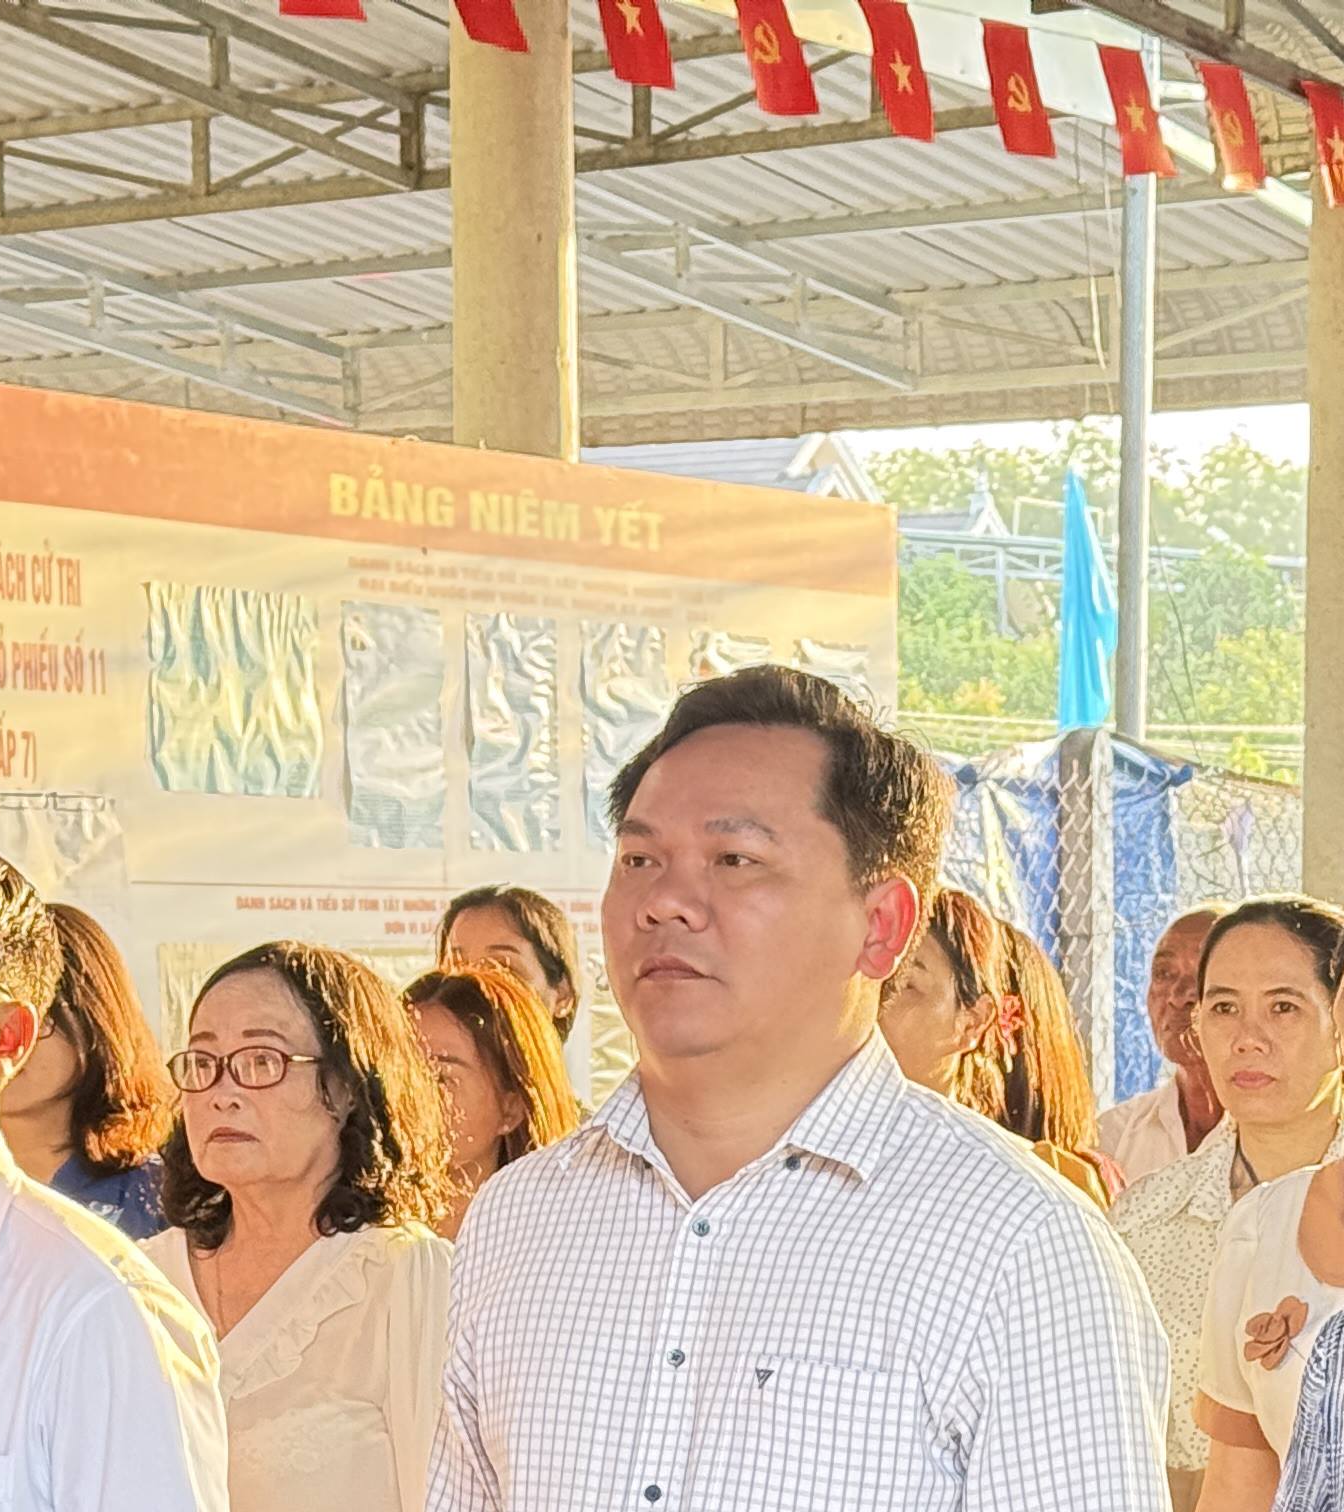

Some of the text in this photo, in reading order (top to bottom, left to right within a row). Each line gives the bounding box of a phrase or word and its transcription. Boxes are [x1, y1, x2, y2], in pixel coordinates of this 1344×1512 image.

[329, 464, 665, 552] BẢNG NIÊM YẾT
[30, 538, 56, 605] CỬ
[56, 557, 82, 607] TRI
[12, 627, 59, 694] PHIẾU
[63, 627, 84, 695] SỐ
[89, 648, 107, 697] 11
[20, 730, 37, 780] 7)
